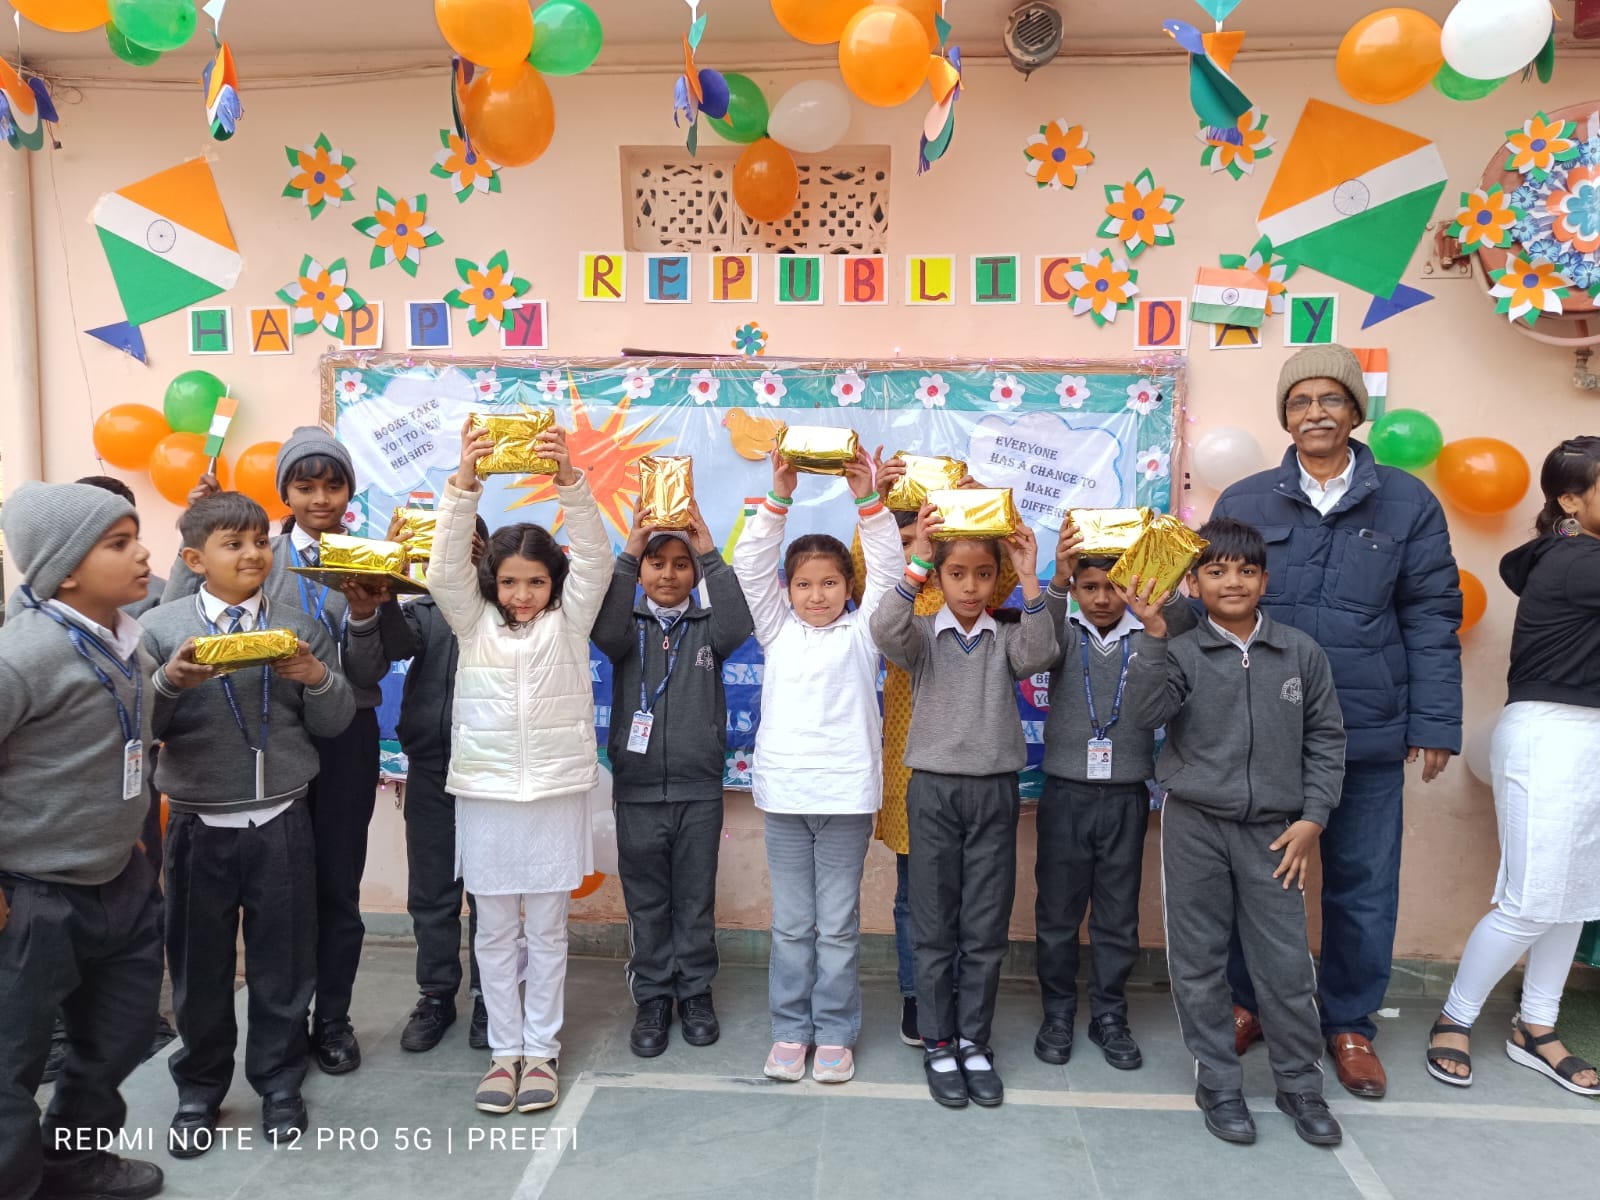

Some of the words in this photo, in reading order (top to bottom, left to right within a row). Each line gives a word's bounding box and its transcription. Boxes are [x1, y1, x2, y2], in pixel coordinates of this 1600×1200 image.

[195, 303, 539, 353] HAPPY
[591, 254, 1072, 303] REPUBLIC
[374, 416, 409, 441] BOOKS
[408, 398, 440, 421] TAKE
[381, 437, 404, 456] YOU
[403, 430, 419, 443] TO
[995, 435, 1059, 460] EVERYONE
[990, 452, 1016, 468] HAS
[1017, 460, 1027, 471] A
[1030, 464, 1079, 485] CHANCE
[1081, 476, 1097, 489] TO
[1024, 481, 1062, 499] MAKE
